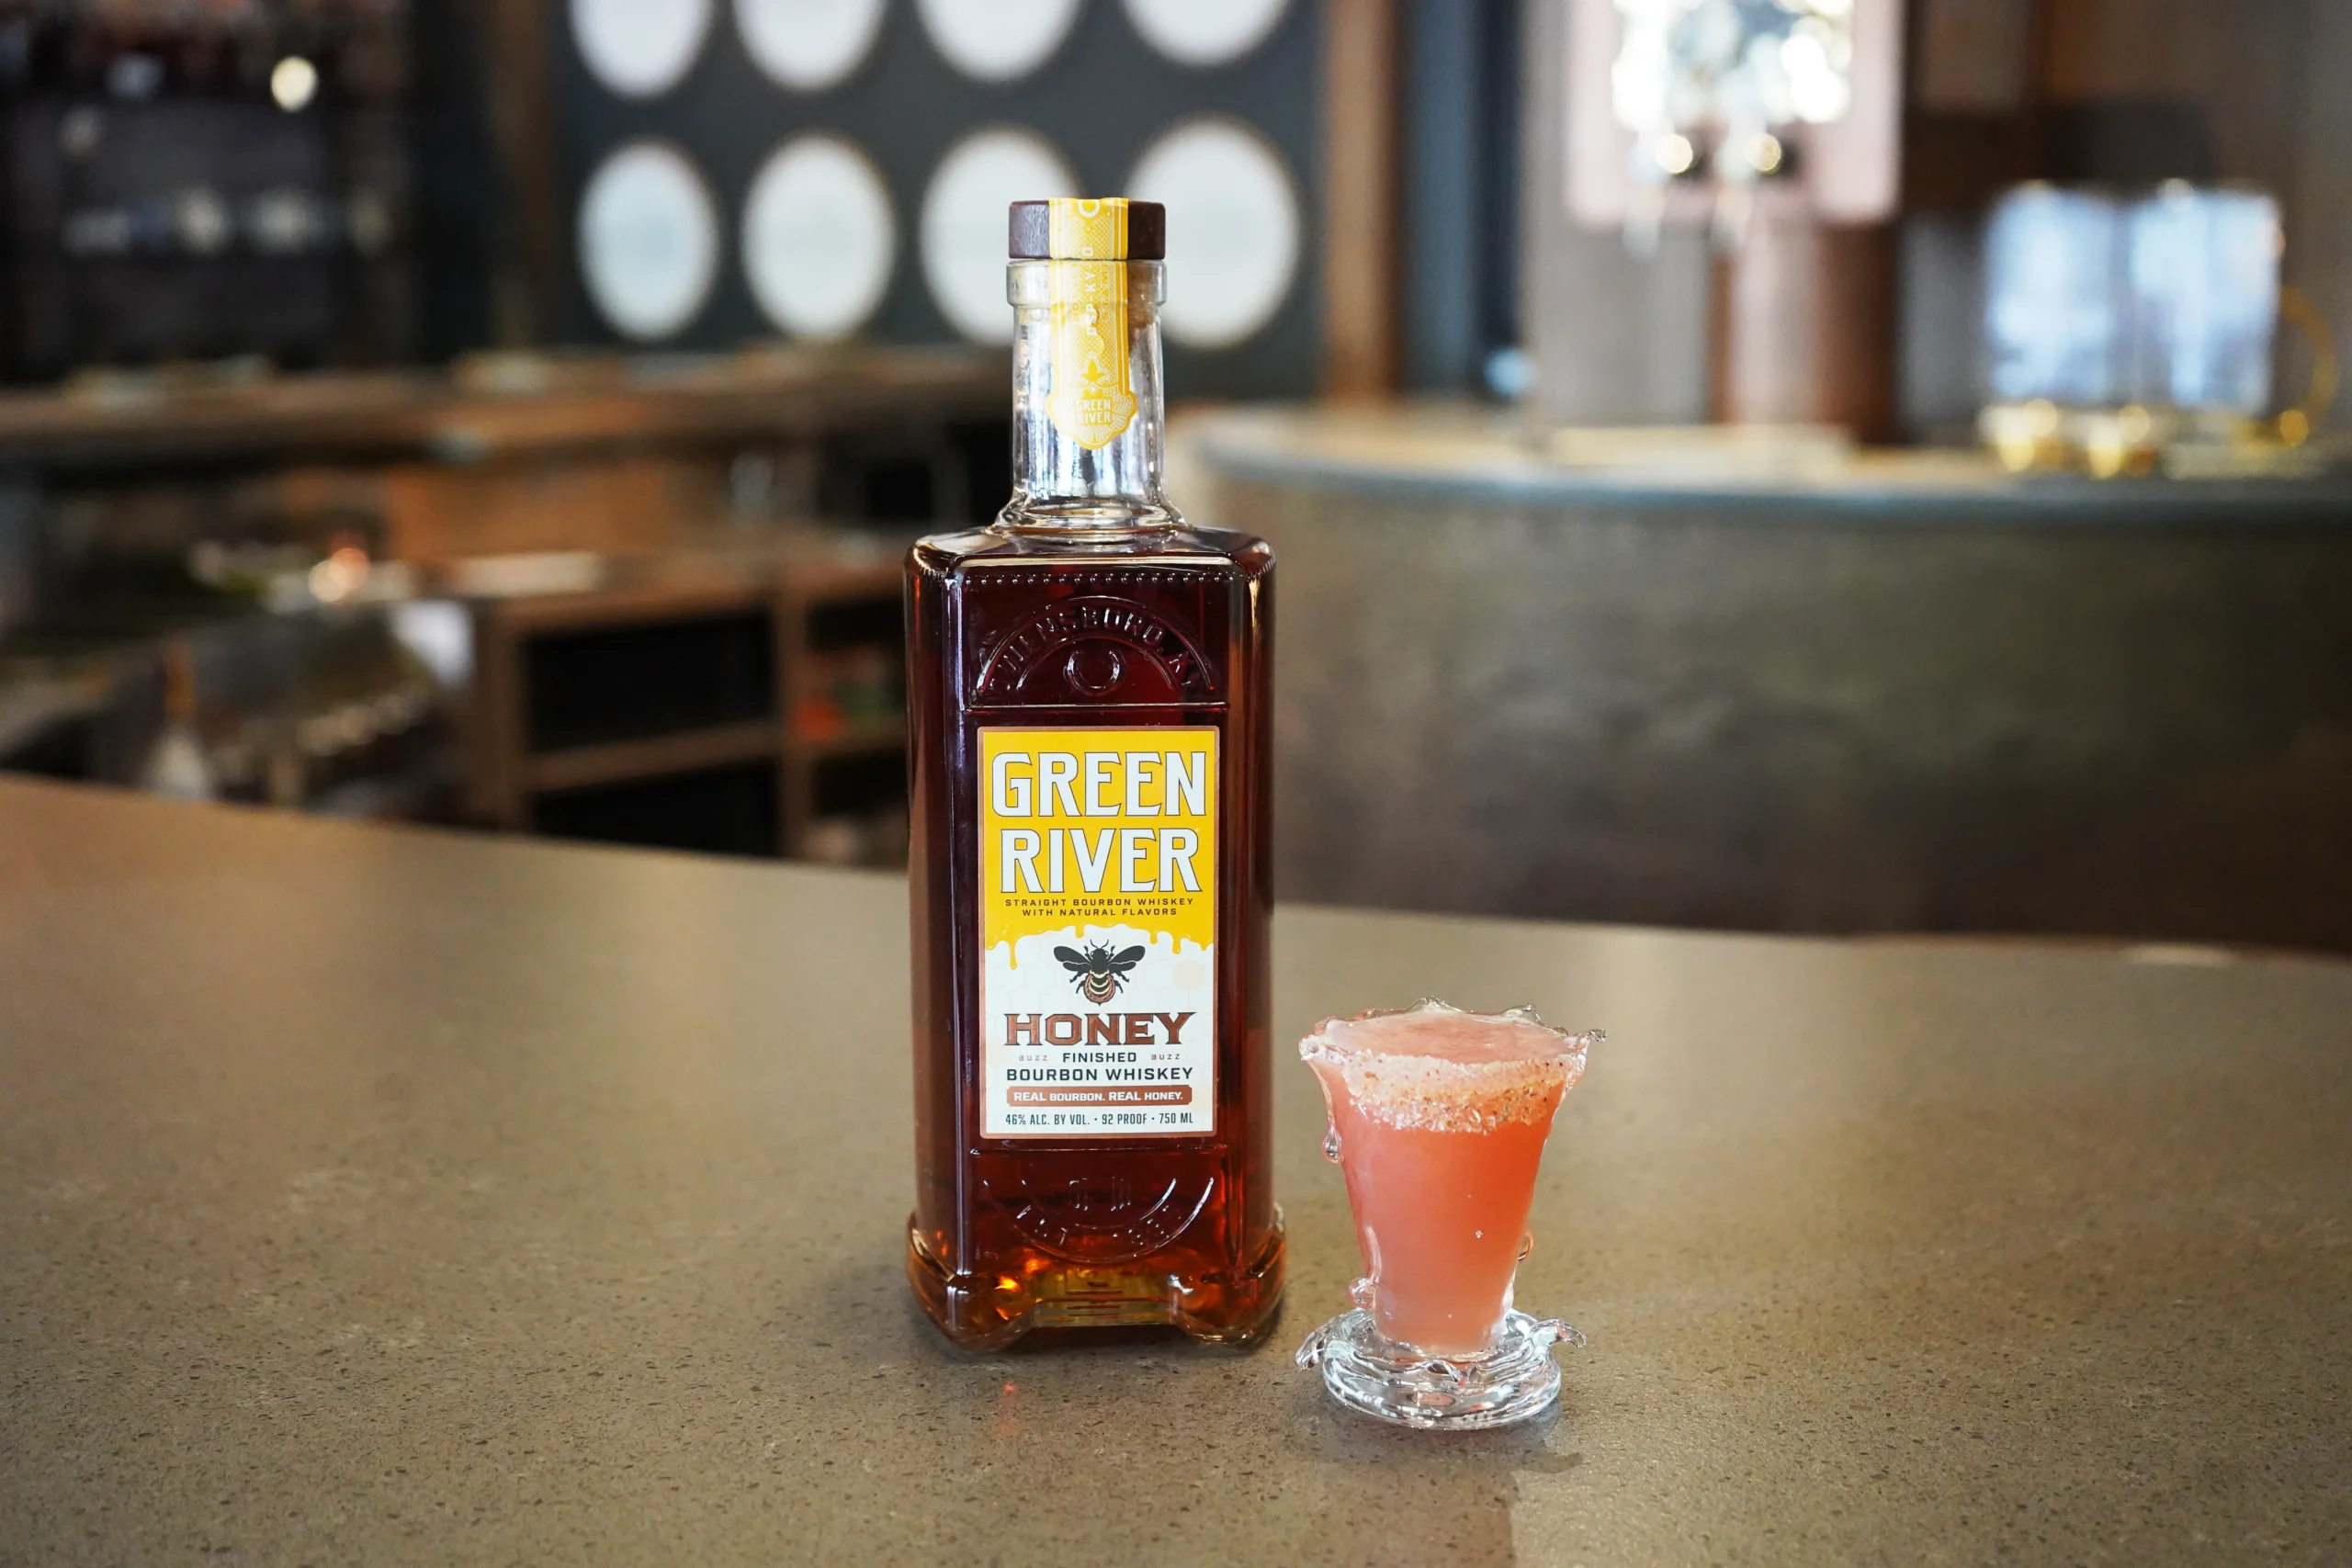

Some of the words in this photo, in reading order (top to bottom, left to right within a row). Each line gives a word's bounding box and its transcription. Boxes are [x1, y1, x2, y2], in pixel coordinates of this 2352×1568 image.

[1075, 399, 1112, 411] GREEN
[1076, 412, 1112, 423] RIVER
[992, 751, 1207, 817] GREEN
[1001, 828, 1203, 894] RIVER
[1005, 898, 1067, 907] STRAIGHT
[1072, 898, 1131, 907] BOURBON
[1137, 897, 1193, 906] WHISKEY
[1022, 908, 1053, 917] WITH
[1122, 908, 1177, 916] FLAVORS
[1003, 1012, 1197, 1046] HONEY
[1062, 1052, 1136, 1063] FINISHED
[1150, 1053, 1181, 1061] BUZZ
[1006, 1068, 1098, 1081] BOURBON
[1105, 1066, 1193, 1081] WHISKEY
[1013, 1091, 1047, 1101] REAL
[1049, 1092, 1105, 1101] BOURBON.
[1108, 1091, 1142, 1101] REAL
[1144, 1091, 1183, 1100] HONEY.
[1005, 1113, 1026, 1125] 46%
[1030, 1113, 1050, 1125] ALC.
[1054, 1113, 1066, 1125] BY
[1069, 1113, 1091, 1125] VOL.
[1102, 1113, 1114, 1125] 92
[1117, 1113, 1148, 1125] PROOF
[1159, 1112, 1176, 1124] 750
[1180, 1111, 1193, 1123] ML
